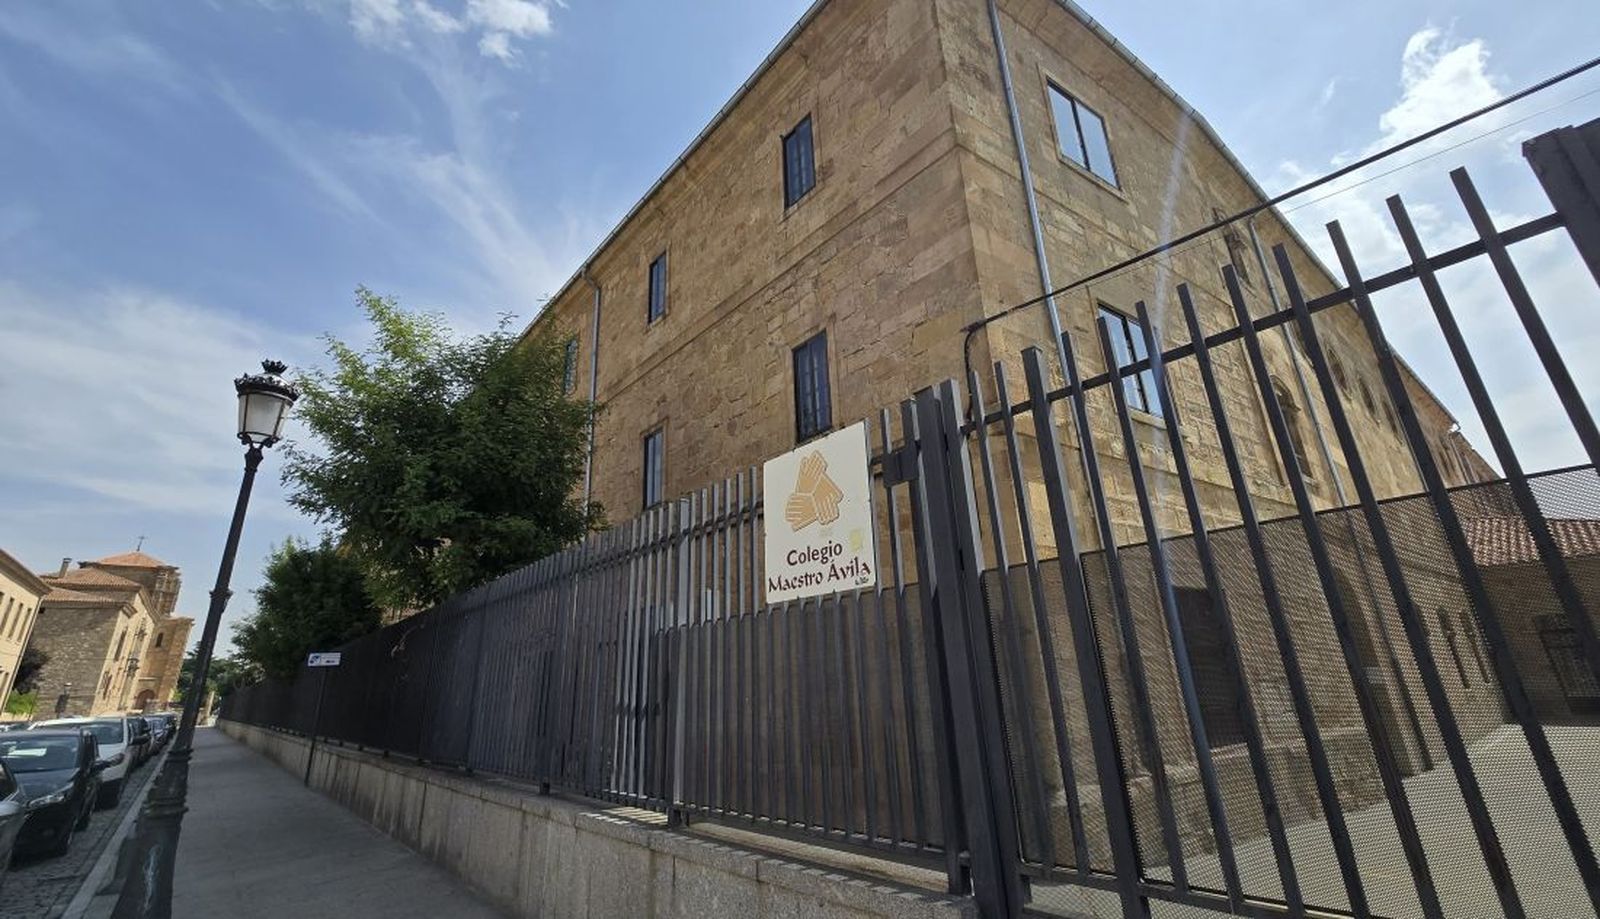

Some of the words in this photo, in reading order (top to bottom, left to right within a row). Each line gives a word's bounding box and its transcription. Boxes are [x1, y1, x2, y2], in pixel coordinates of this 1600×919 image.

[787, 540, 843, 566] Colegio
[768, 572, 823, 592] Maestro
[827, 556, 871, 582] Ávila
